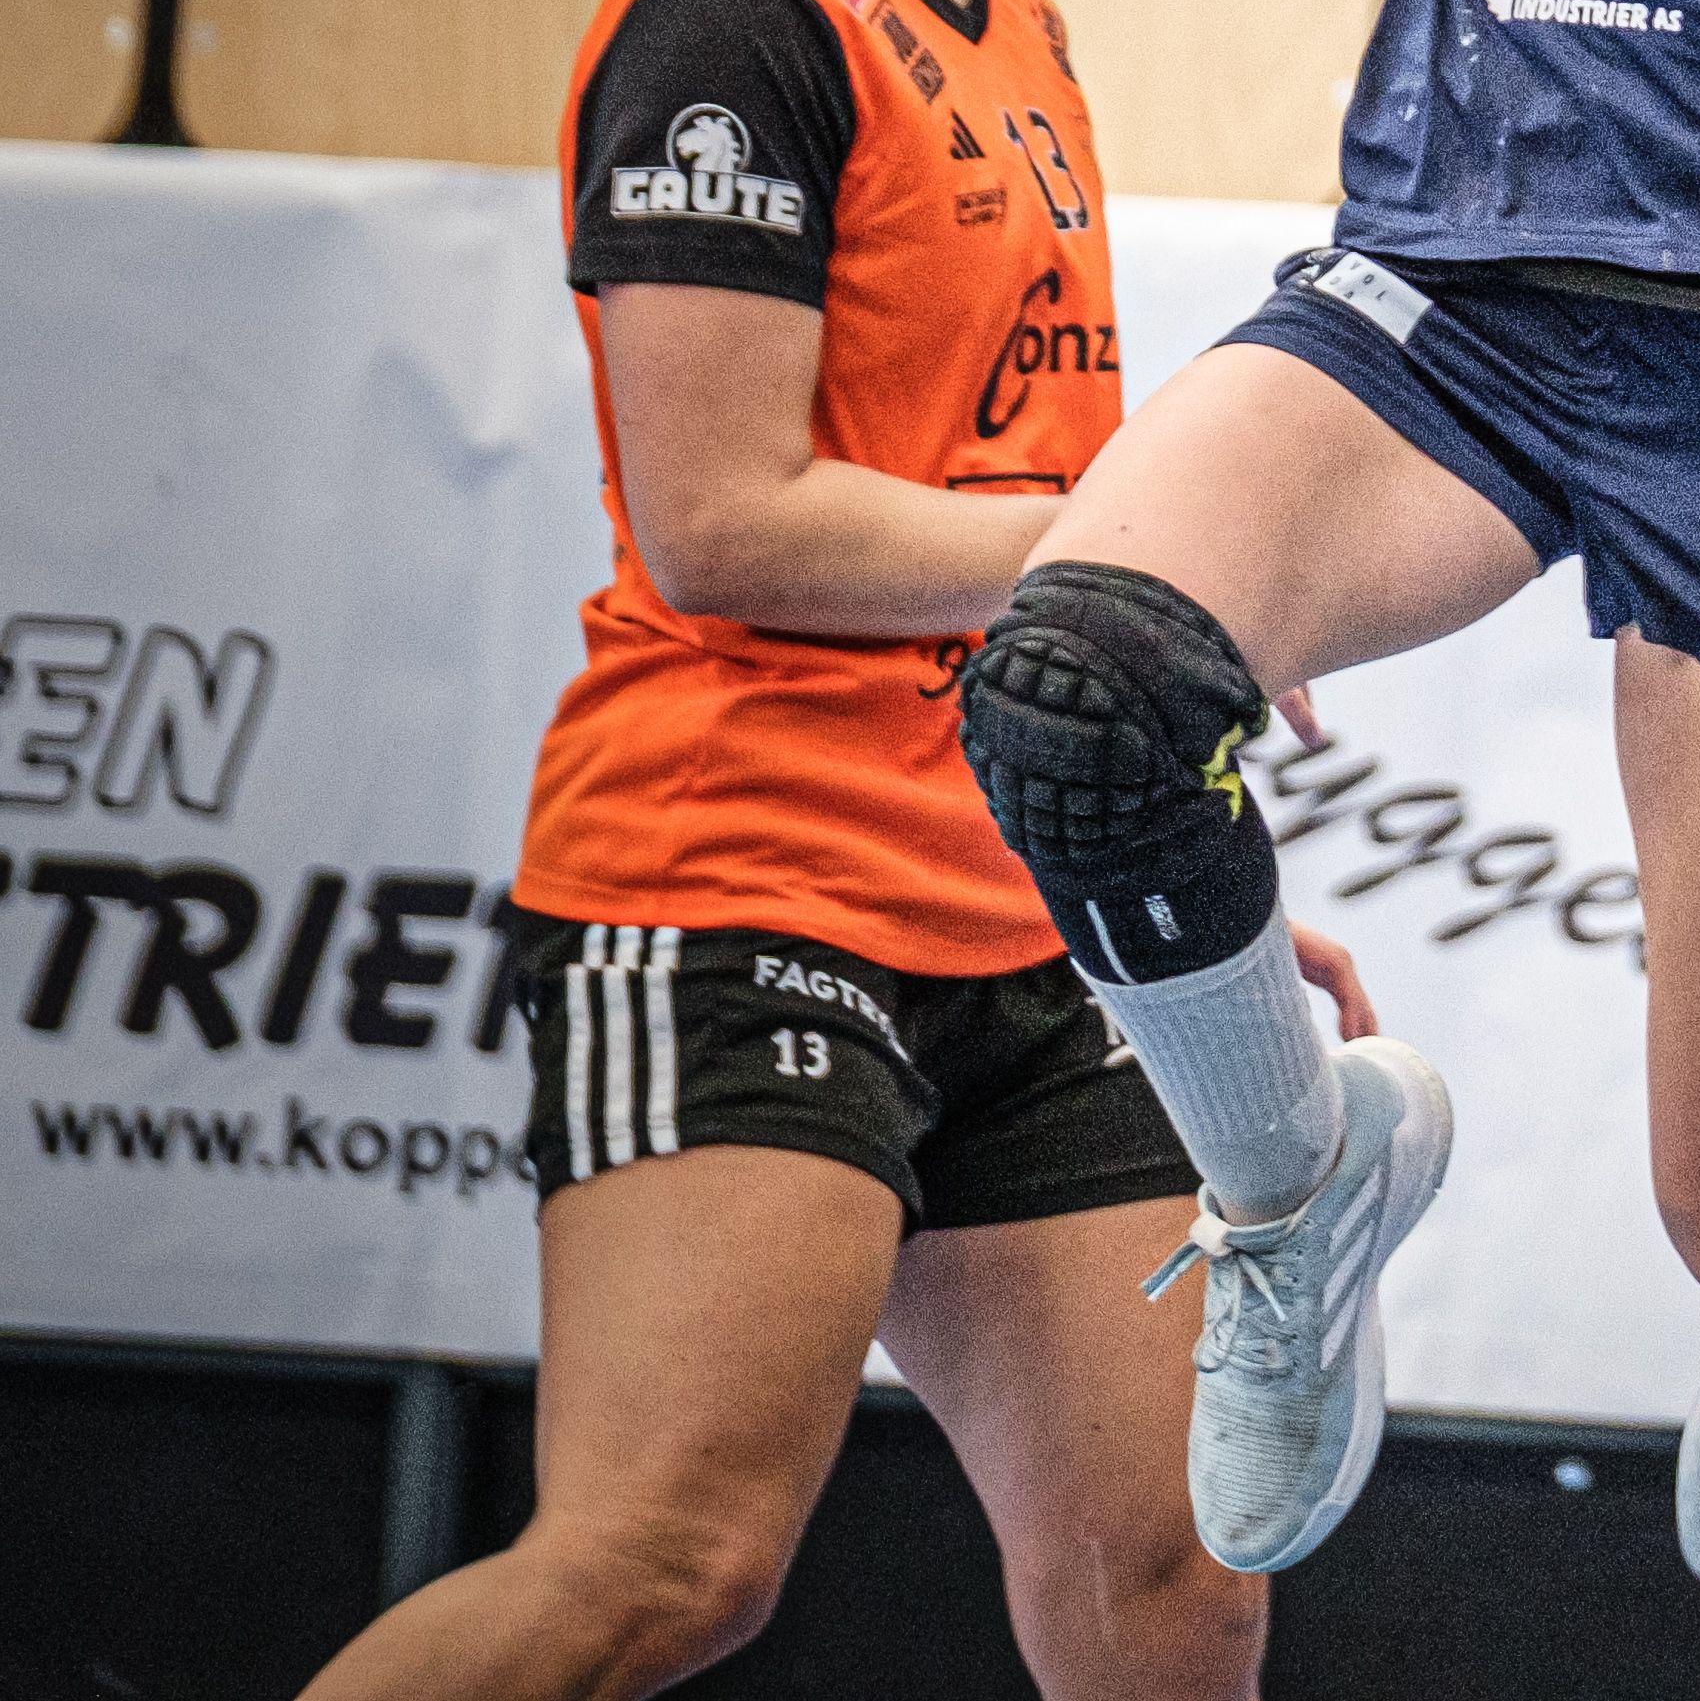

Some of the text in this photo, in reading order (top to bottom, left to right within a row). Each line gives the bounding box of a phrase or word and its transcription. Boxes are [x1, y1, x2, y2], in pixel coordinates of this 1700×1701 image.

[1652, 6, 1685, 33] AS
[615, 170, 803, 229] GAUTE
[1002, 106, 1090, 231] 13
[0, 612, 278, 817] EN
[0, 852, 516, 1055] TRIE
[770, 1027, 832, 1080] 13
